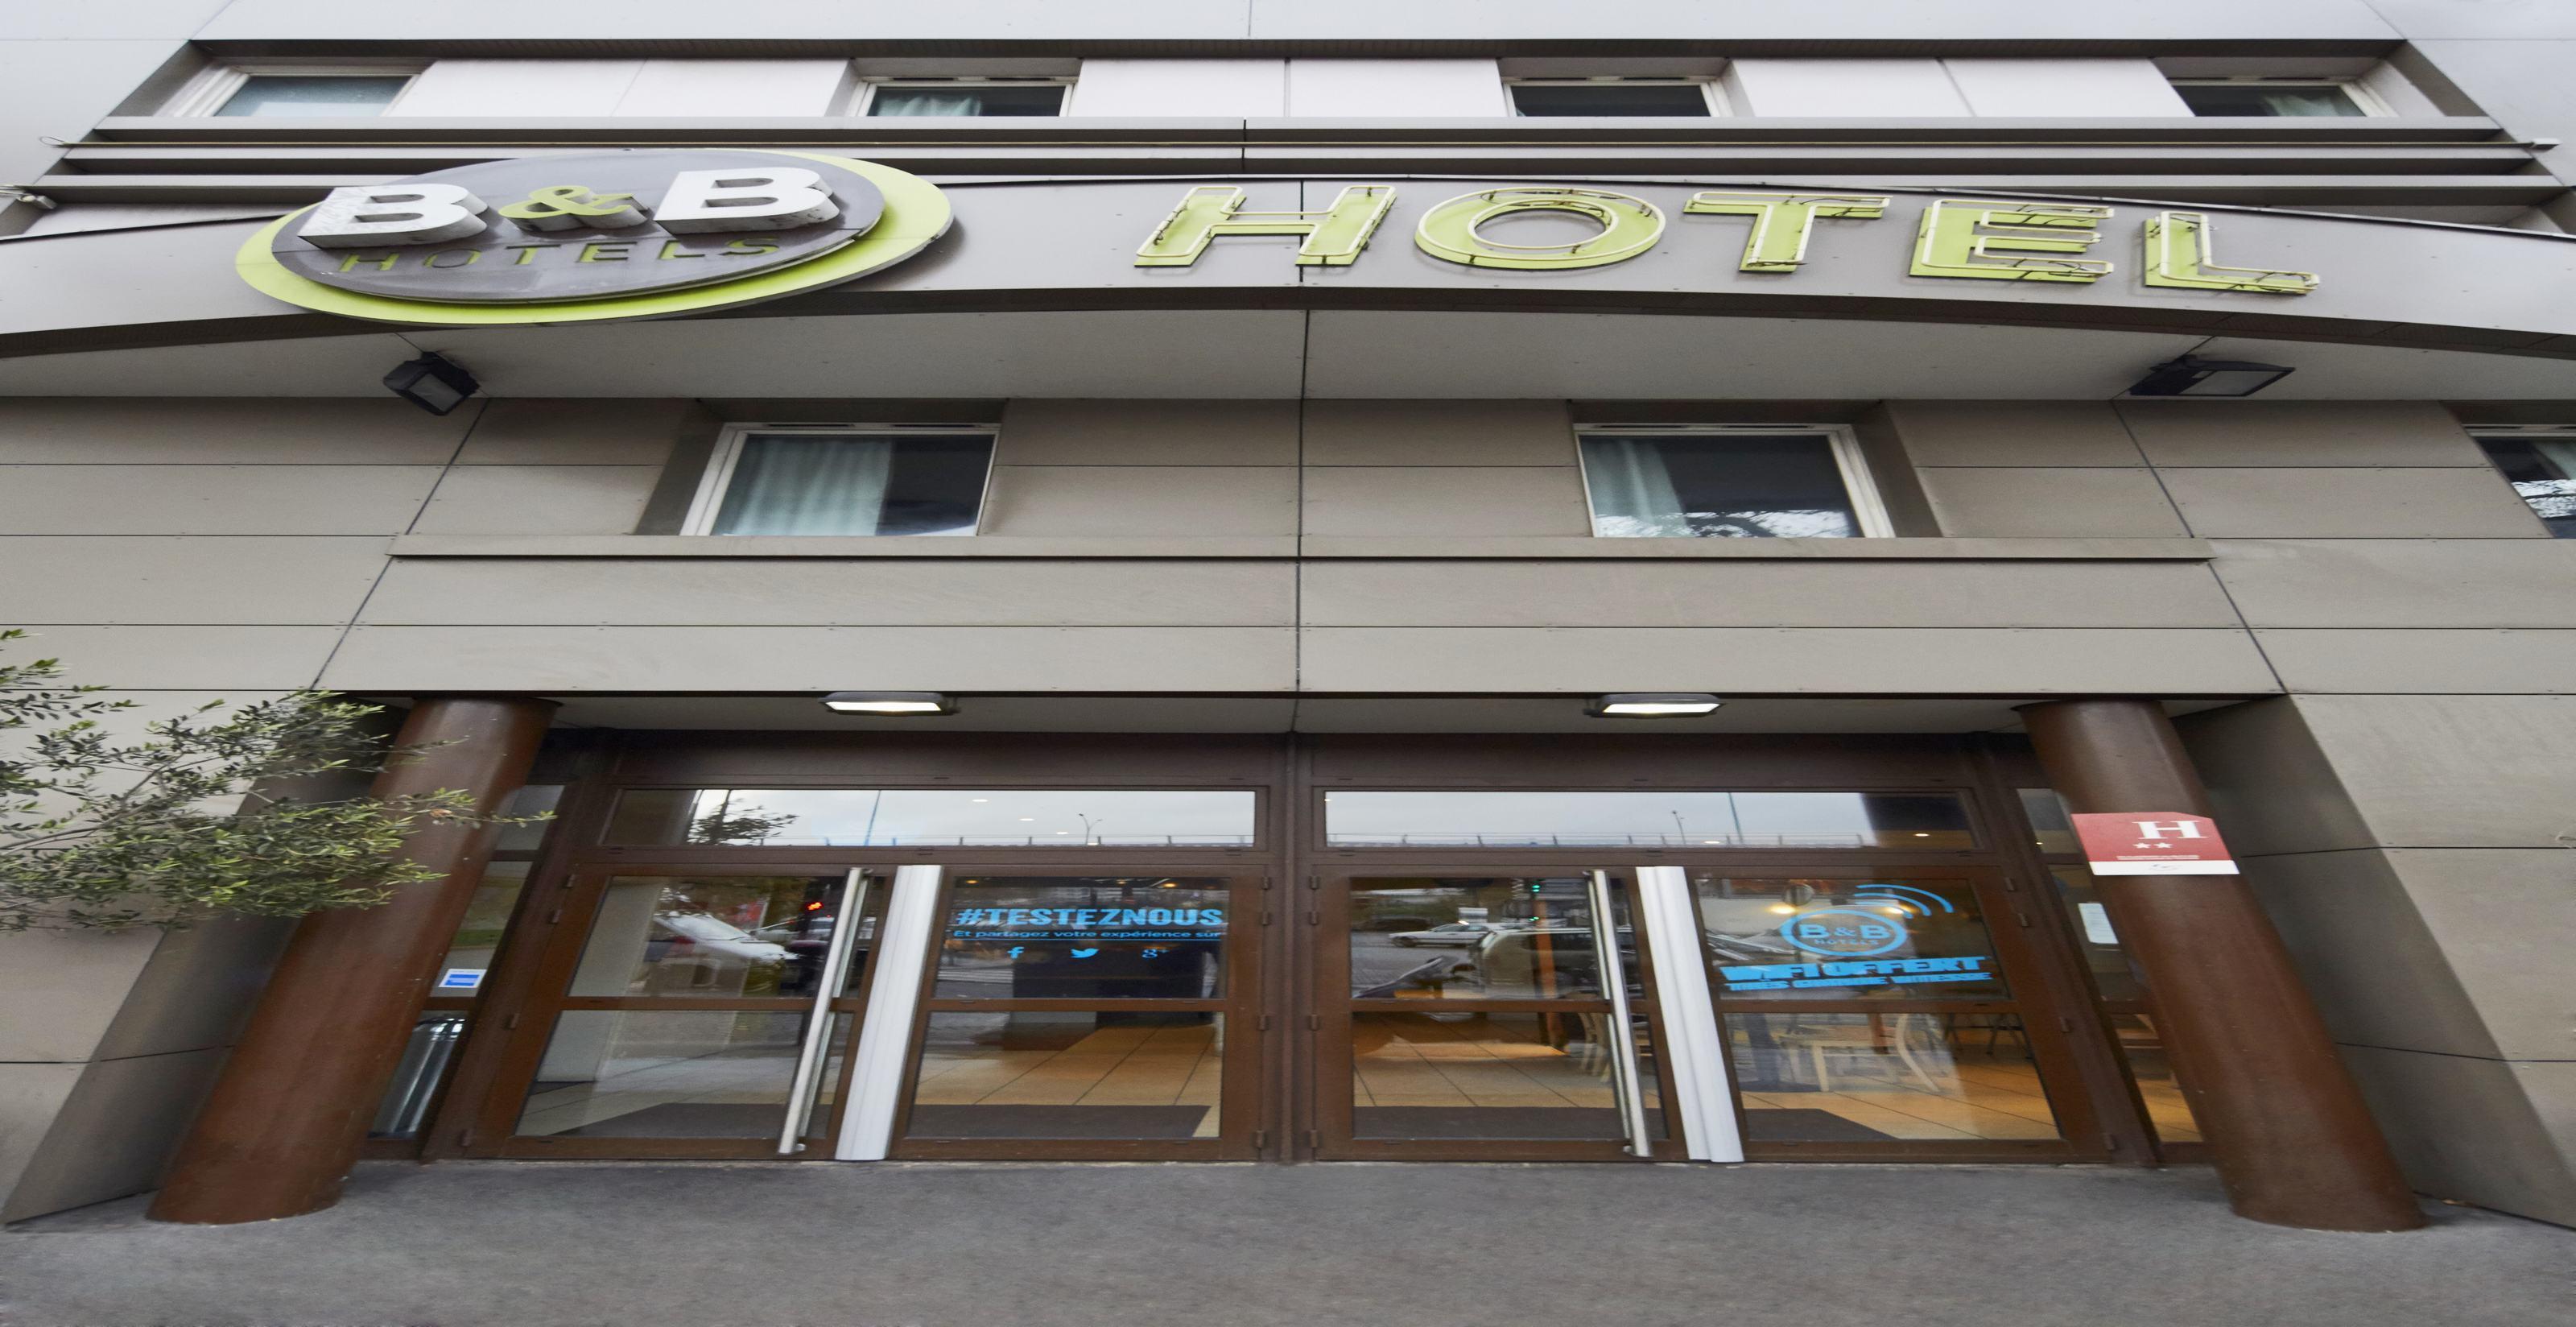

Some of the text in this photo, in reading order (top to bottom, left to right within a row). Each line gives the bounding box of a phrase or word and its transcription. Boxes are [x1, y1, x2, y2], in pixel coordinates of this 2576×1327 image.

[297, 166, 840, 249] B&B
[1134, 184, 2320, 296] HOTEL
[338, 236, 782, 273] HOTELS
[2132, 820, 2208, 840] H
[956, 907, 1224, 926] #TESTEZNOUS
[1100, 930, 1191, 938] expérience
[1821, 957, 1985, 977] OFFERT
